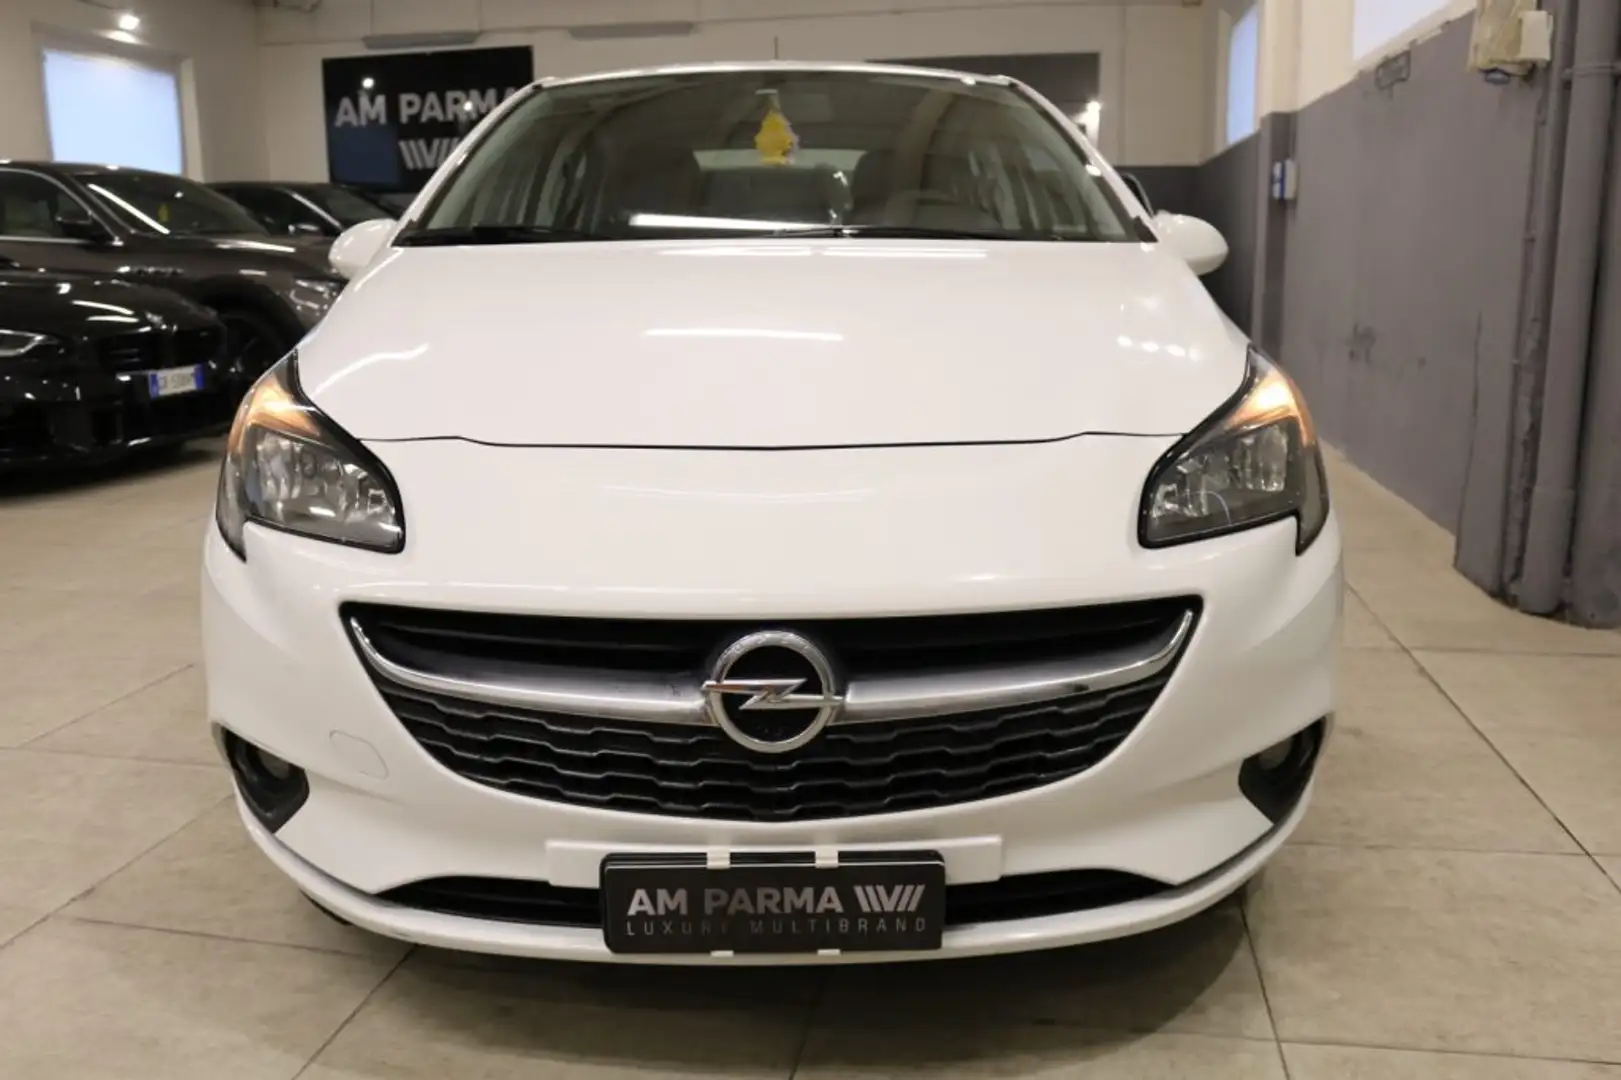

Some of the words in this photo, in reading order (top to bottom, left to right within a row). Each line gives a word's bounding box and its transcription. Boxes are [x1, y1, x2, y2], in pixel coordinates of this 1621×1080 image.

[334, 94, 387, 127] AM
[627, 888, 688, 916] AM
[704, 886, 845, 915] PARMA
[750, 917, 926, 935] MULTIBRAND
